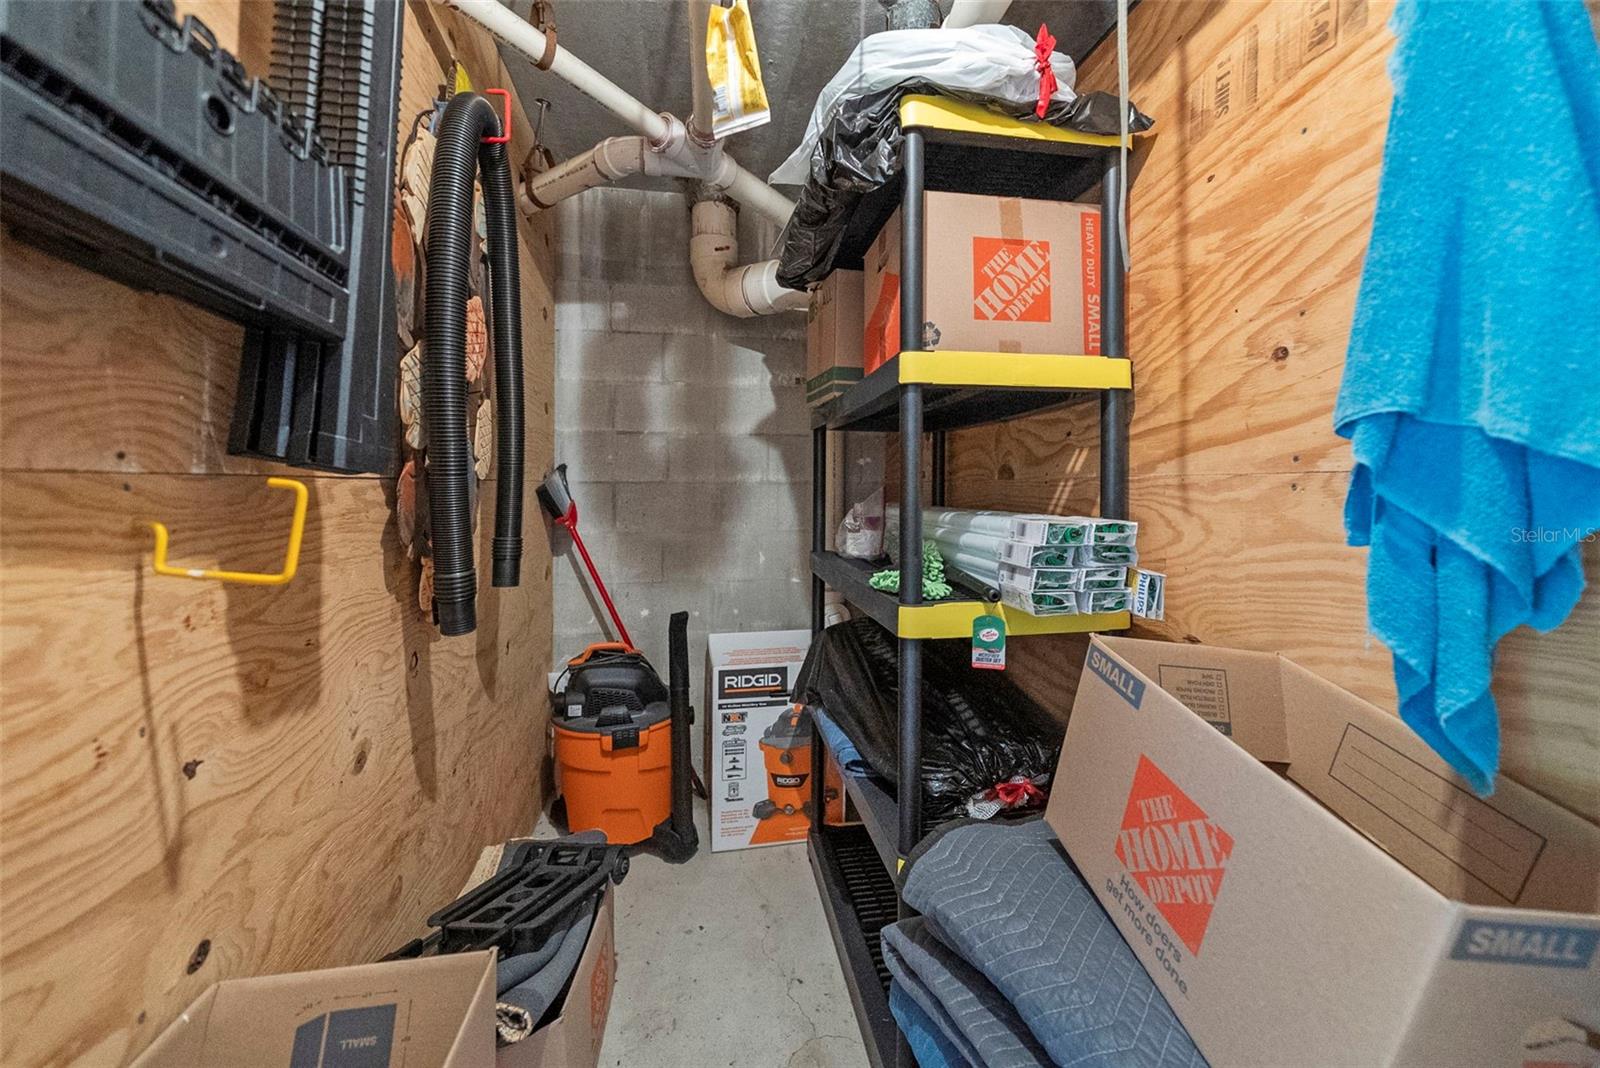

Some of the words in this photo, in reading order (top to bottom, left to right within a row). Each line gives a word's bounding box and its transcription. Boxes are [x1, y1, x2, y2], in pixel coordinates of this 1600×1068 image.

[1085, 218, 1095, 254] HEAVY
[974, 240, 1051, 321] HOME
[981, 247, 1013, 279] THE
[1086, 259, 1096, 288] DUTY
[1005, 272, 1051, 321] DEPOT
[1088, 294, 1100, 350] SMALL
[1137, 573, 1149, 614] PHILIPS
[724, 673, 782, 688] RIDGID
[1091, 651, 1136, 700] SMALL
[1137, 795, 1177, 823] THE
[1119, 819, 1230, 873] HOME
[1145, 876, 1215, 904] DEPOT
[1106, 878, 1124, 904] get
[1124, 904, 1153, 946] more
[1120, 875, 1144, 912] How
[1146, 912, 1182, 963] doers
[1466, 927, 1579, 960] SMALL
[340, 1035, 378, 1051] SMALL
